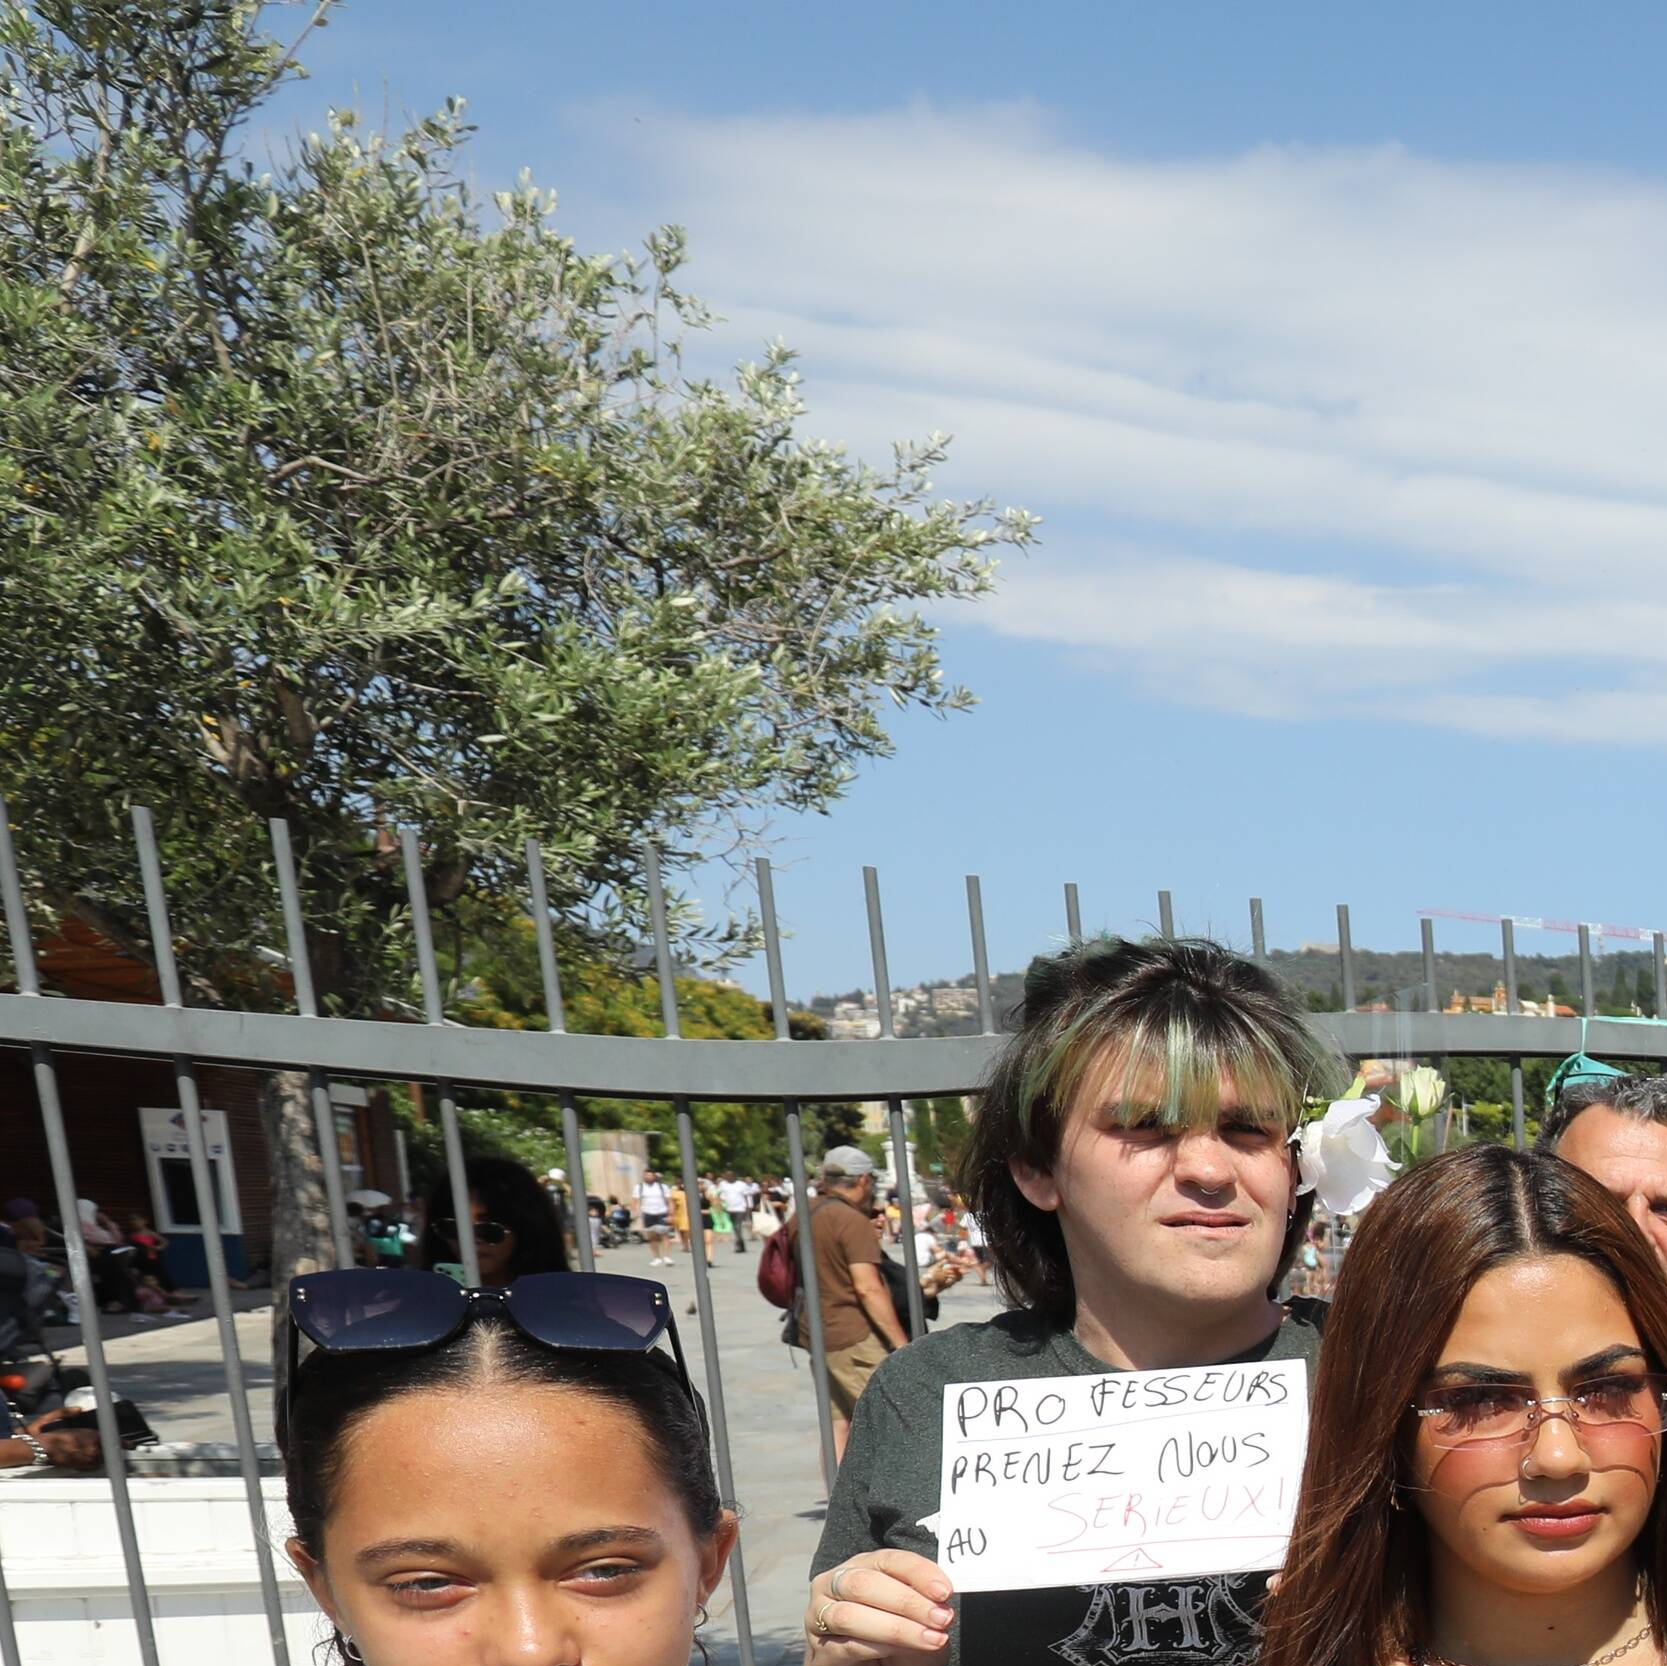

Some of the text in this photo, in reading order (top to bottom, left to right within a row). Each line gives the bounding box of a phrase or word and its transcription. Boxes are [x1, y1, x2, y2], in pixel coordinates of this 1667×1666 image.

[952, 1432, 1269, 1494] PRENEZ NOUS
[946, 1528, 987, 1563] AU
